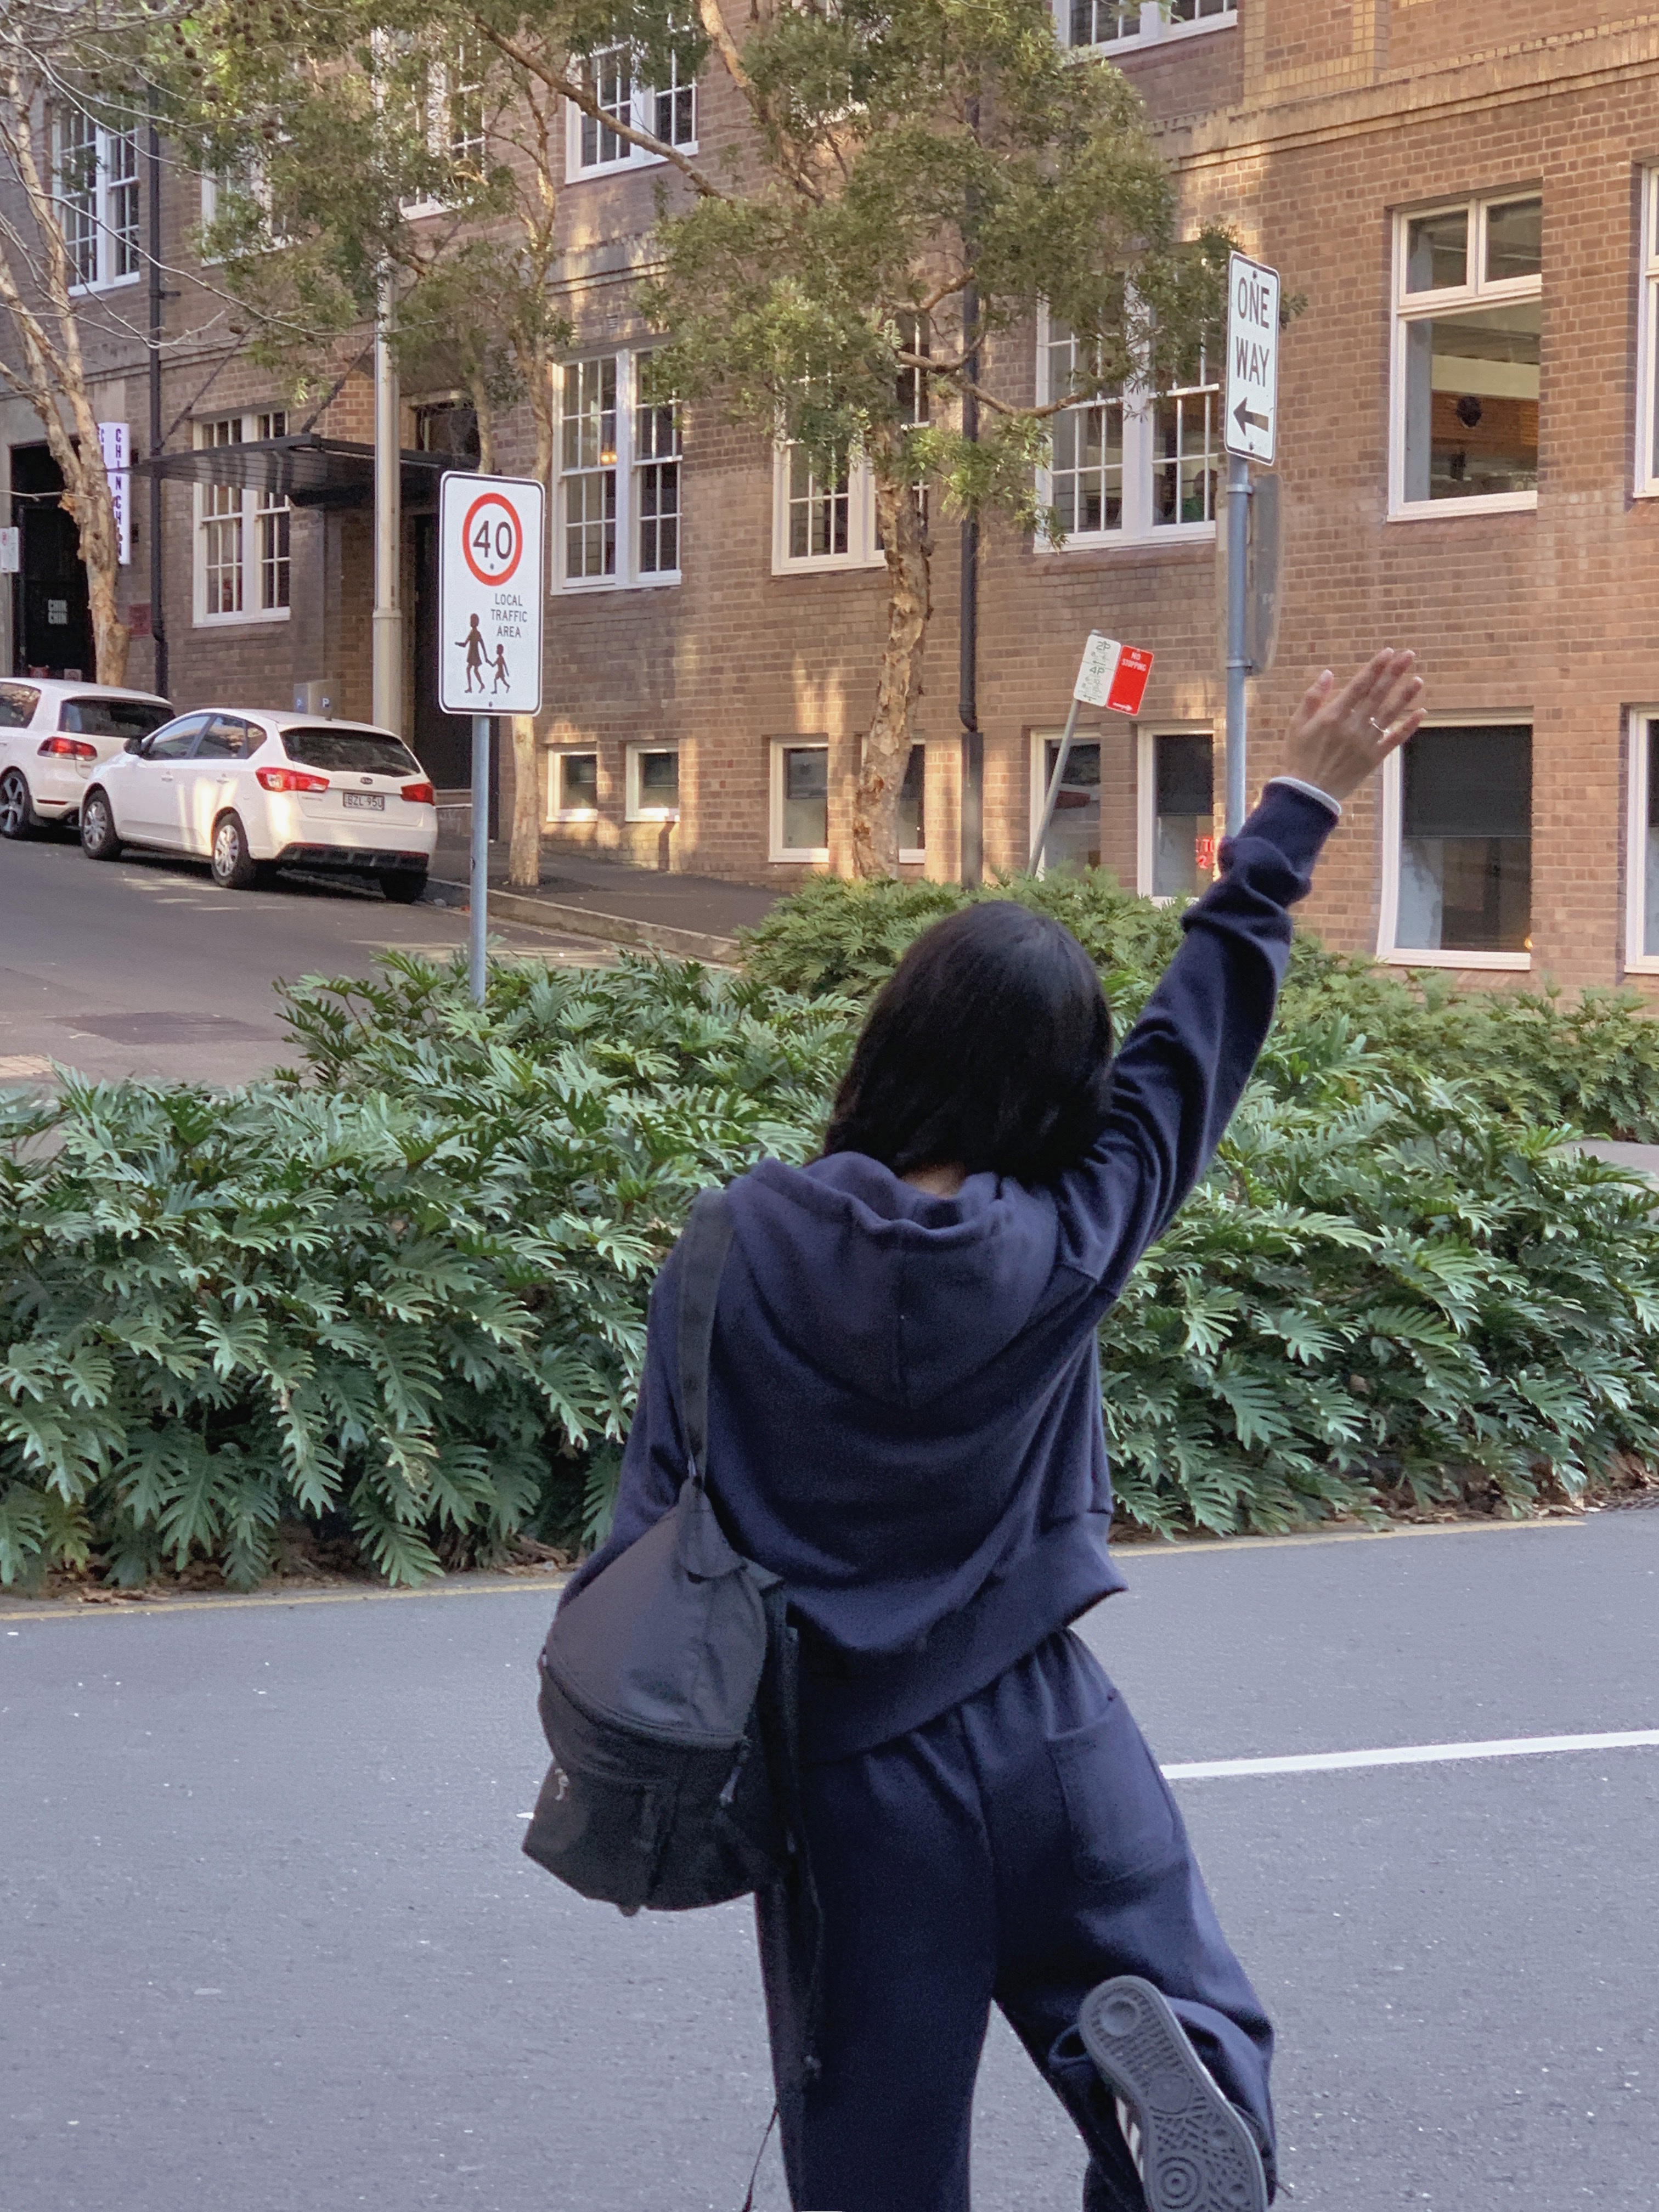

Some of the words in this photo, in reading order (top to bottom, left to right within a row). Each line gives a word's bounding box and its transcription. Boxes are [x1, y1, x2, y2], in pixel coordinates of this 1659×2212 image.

[1237, 276, 1270, 329] ONE
[1235, 335, 1270, 388] WAY
[472, 520, 512, 560] 40
[495, 593, 523, 607] LOCAL
[490, 608, 528, 623] TRAFFIC
[496, 625, 522, 638] AREA
[1096, 641, 1111, 651] 2P
[1090, 666, 1105, 675] 4P
[1121, 658, 1147, 672] STOPPING
[323, 697, 330, 707] P
